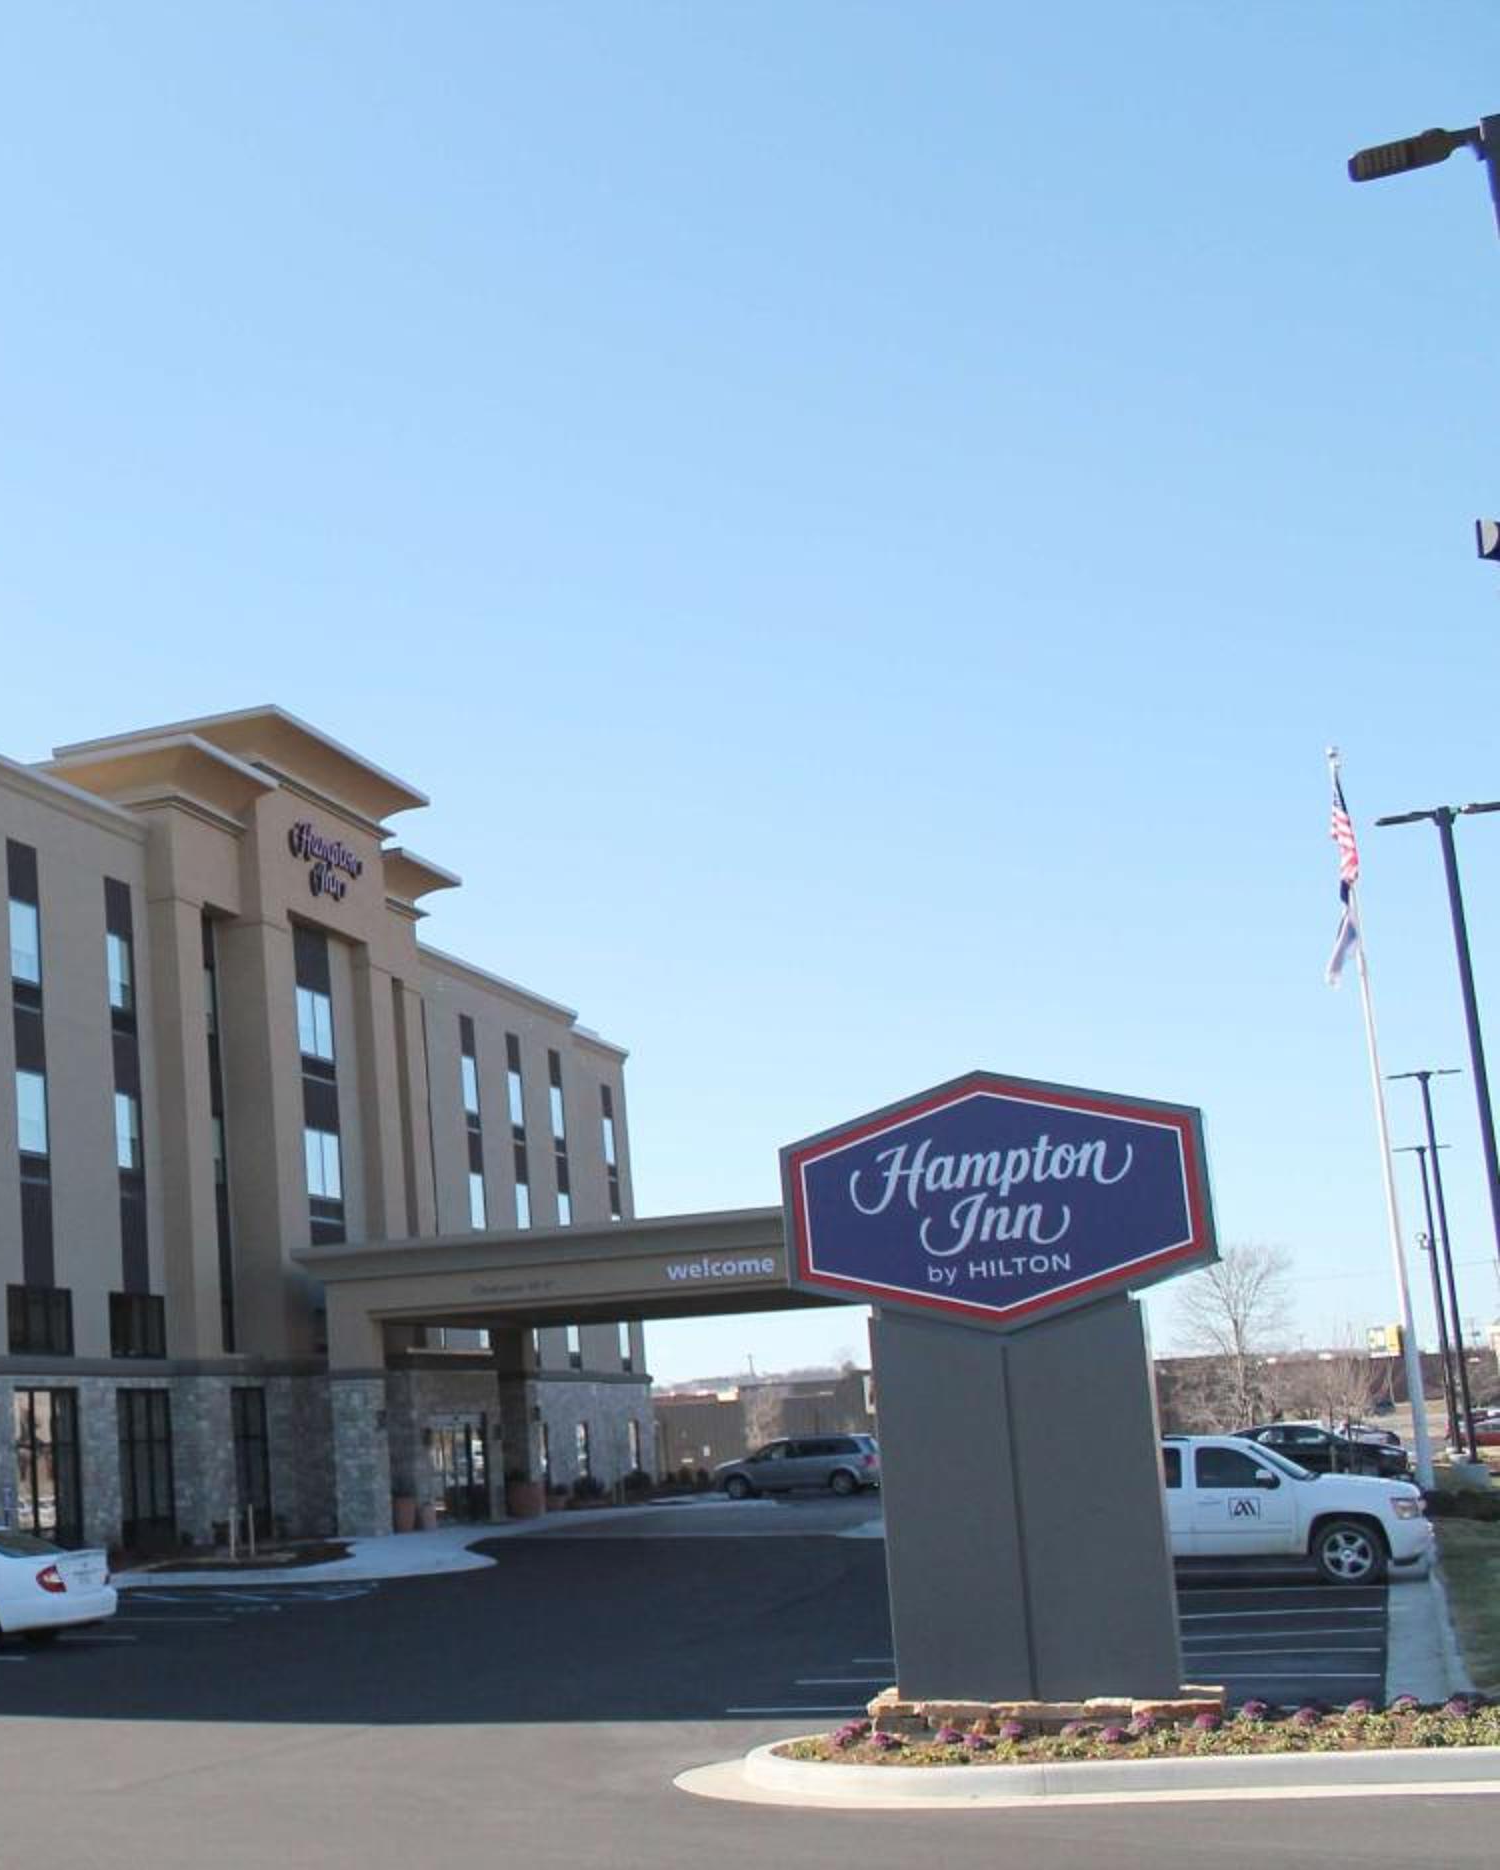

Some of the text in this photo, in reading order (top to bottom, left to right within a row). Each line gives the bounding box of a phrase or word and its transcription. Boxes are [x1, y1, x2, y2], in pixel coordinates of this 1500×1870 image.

[850, 1134, 1132, 1215] Hampton
[921, 1193, 1071, 1257] Inn
[667, 1257, 774, 1281] welcome
[927, 1252, 1071, 1286] by HILTON
